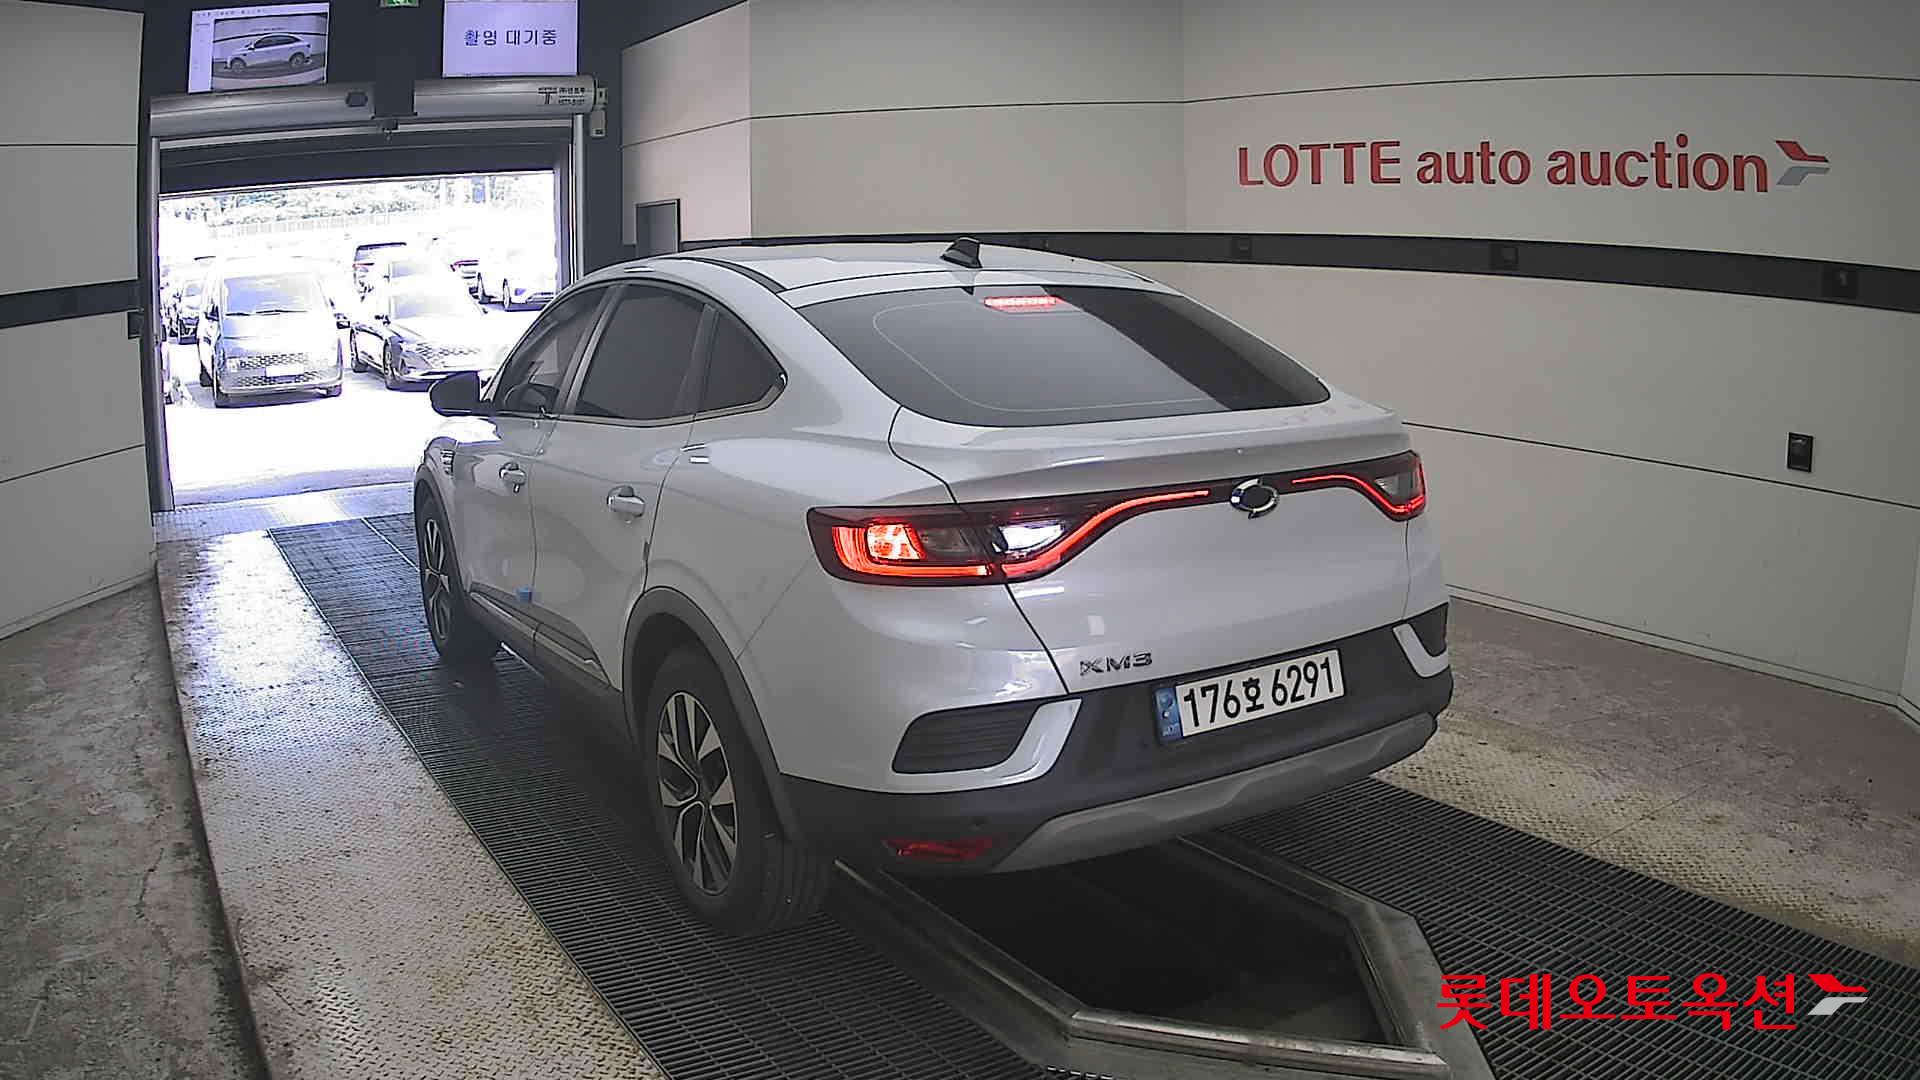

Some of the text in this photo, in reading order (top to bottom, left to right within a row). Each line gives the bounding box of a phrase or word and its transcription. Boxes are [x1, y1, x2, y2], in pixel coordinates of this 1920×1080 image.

[505, 29, 557, 46] 대기중
[1238, 133, 1769, 193] LOTTE auto auction
[1080, 651, 1153, 676] XM3
[1183, 656, 1335, 728] 176호 6291
